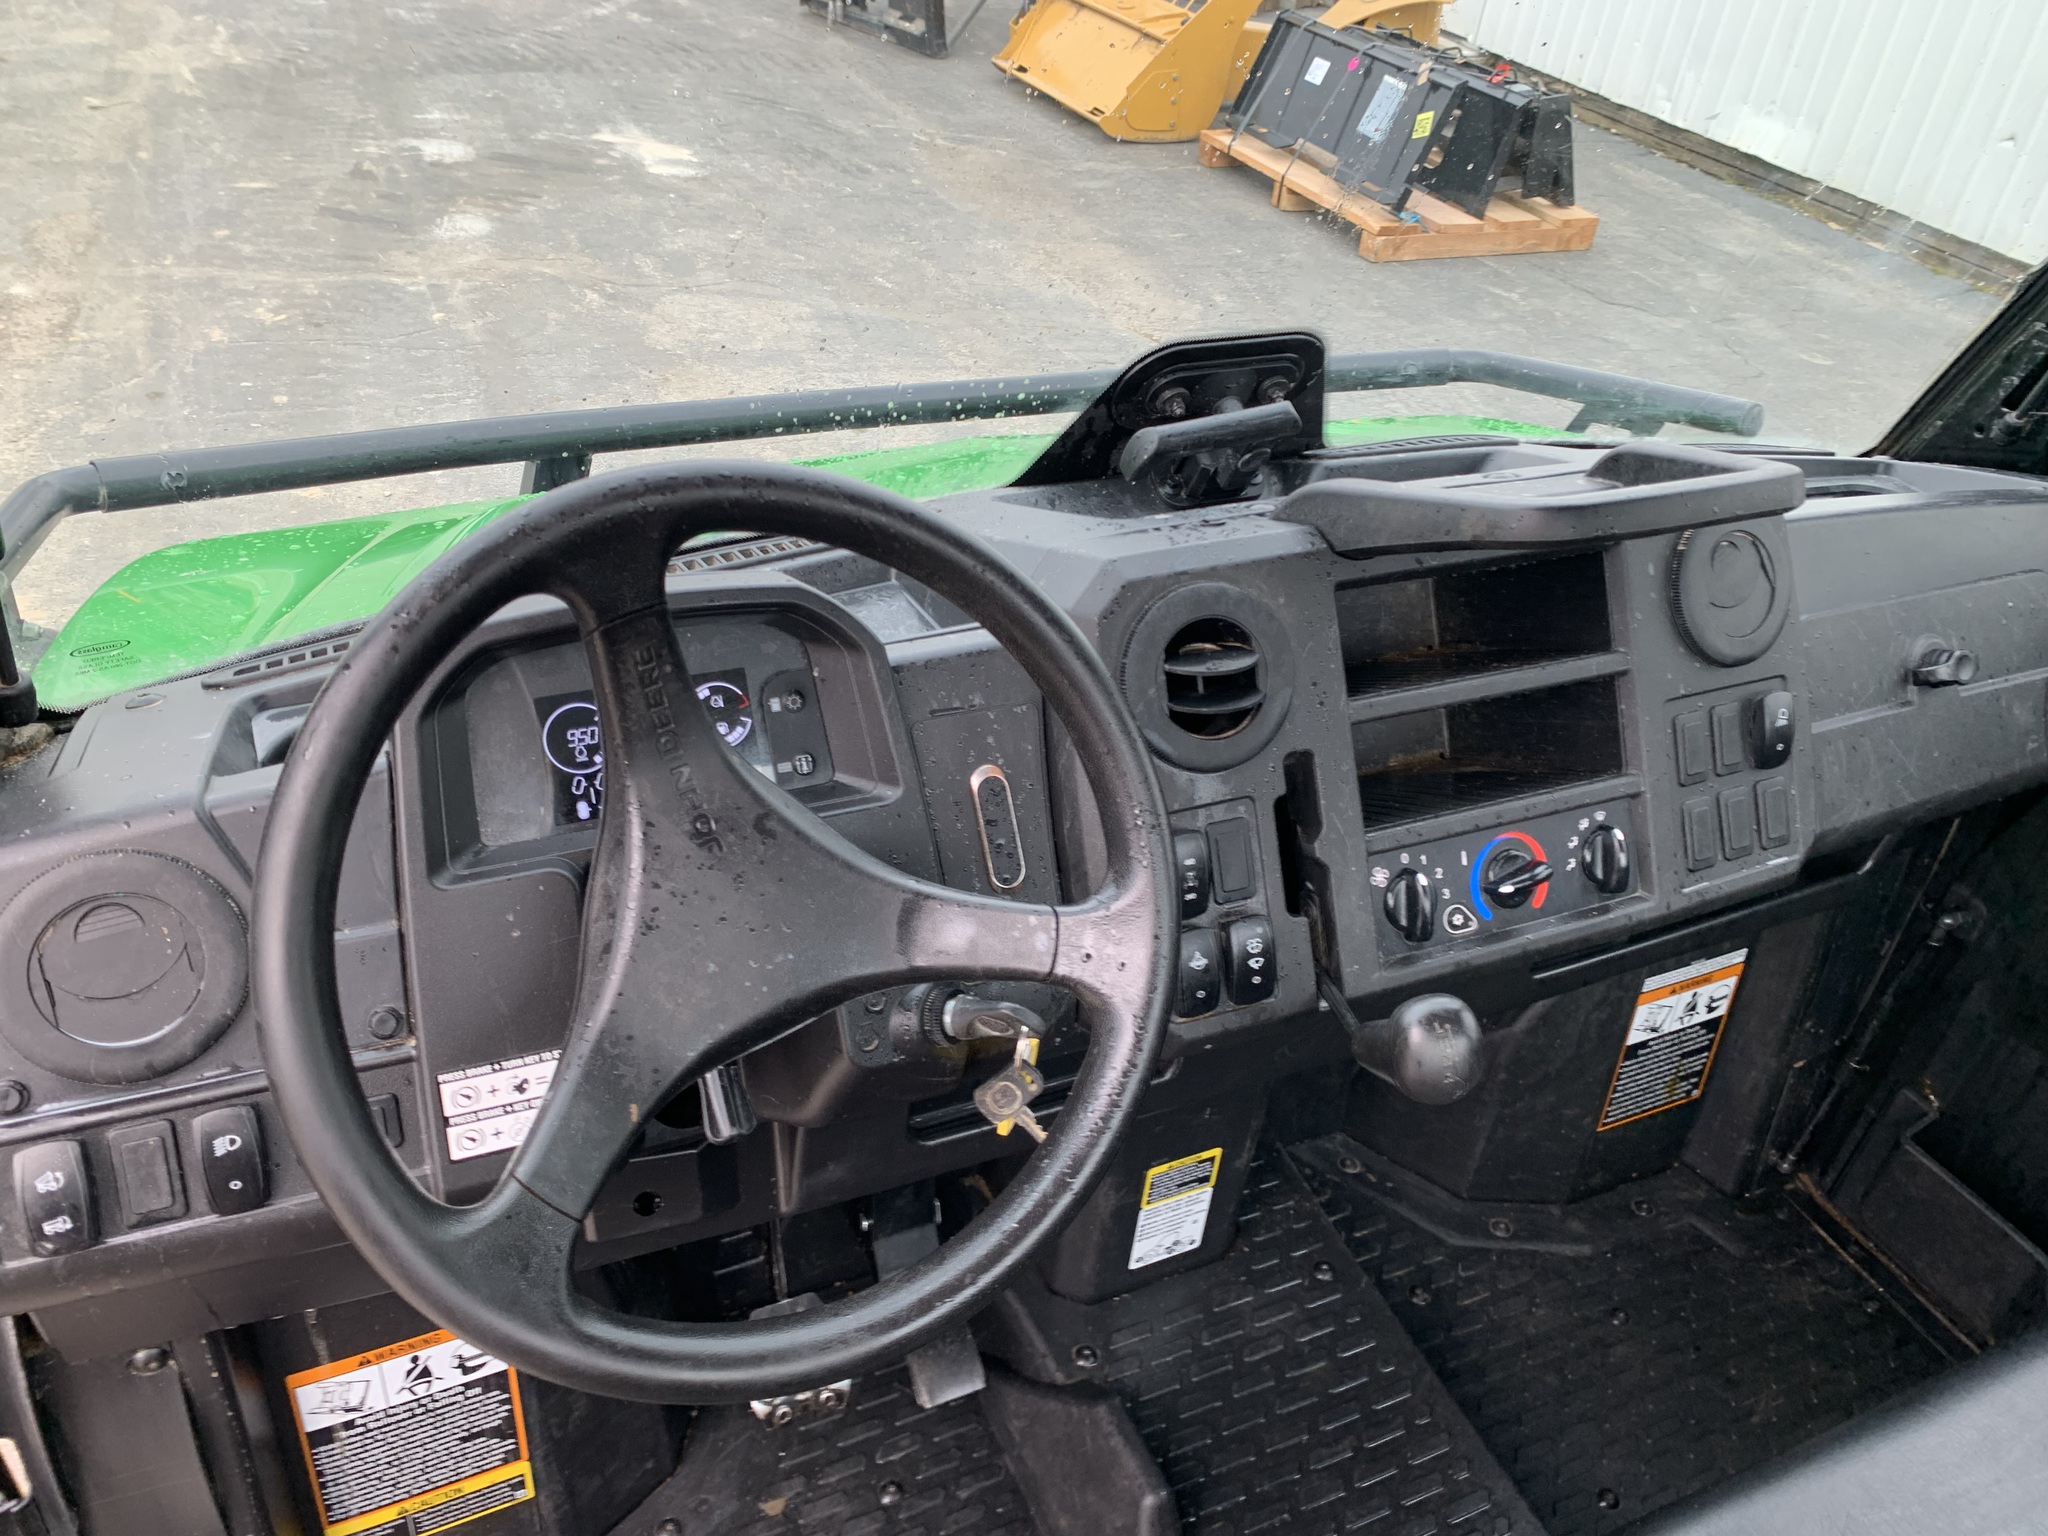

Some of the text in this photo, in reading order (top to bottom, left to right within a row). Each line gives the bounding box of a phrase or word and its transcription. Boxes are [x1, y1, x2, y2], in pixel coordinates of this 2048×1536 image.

[567, 726, 599, 747] 950
[635, 646, 724, 854] JOHN DEERE
[1419, 854, 1428, 866] 1
[1434, 867, 1444, 880] 2
[1441, 888, 1451, 900] 3
